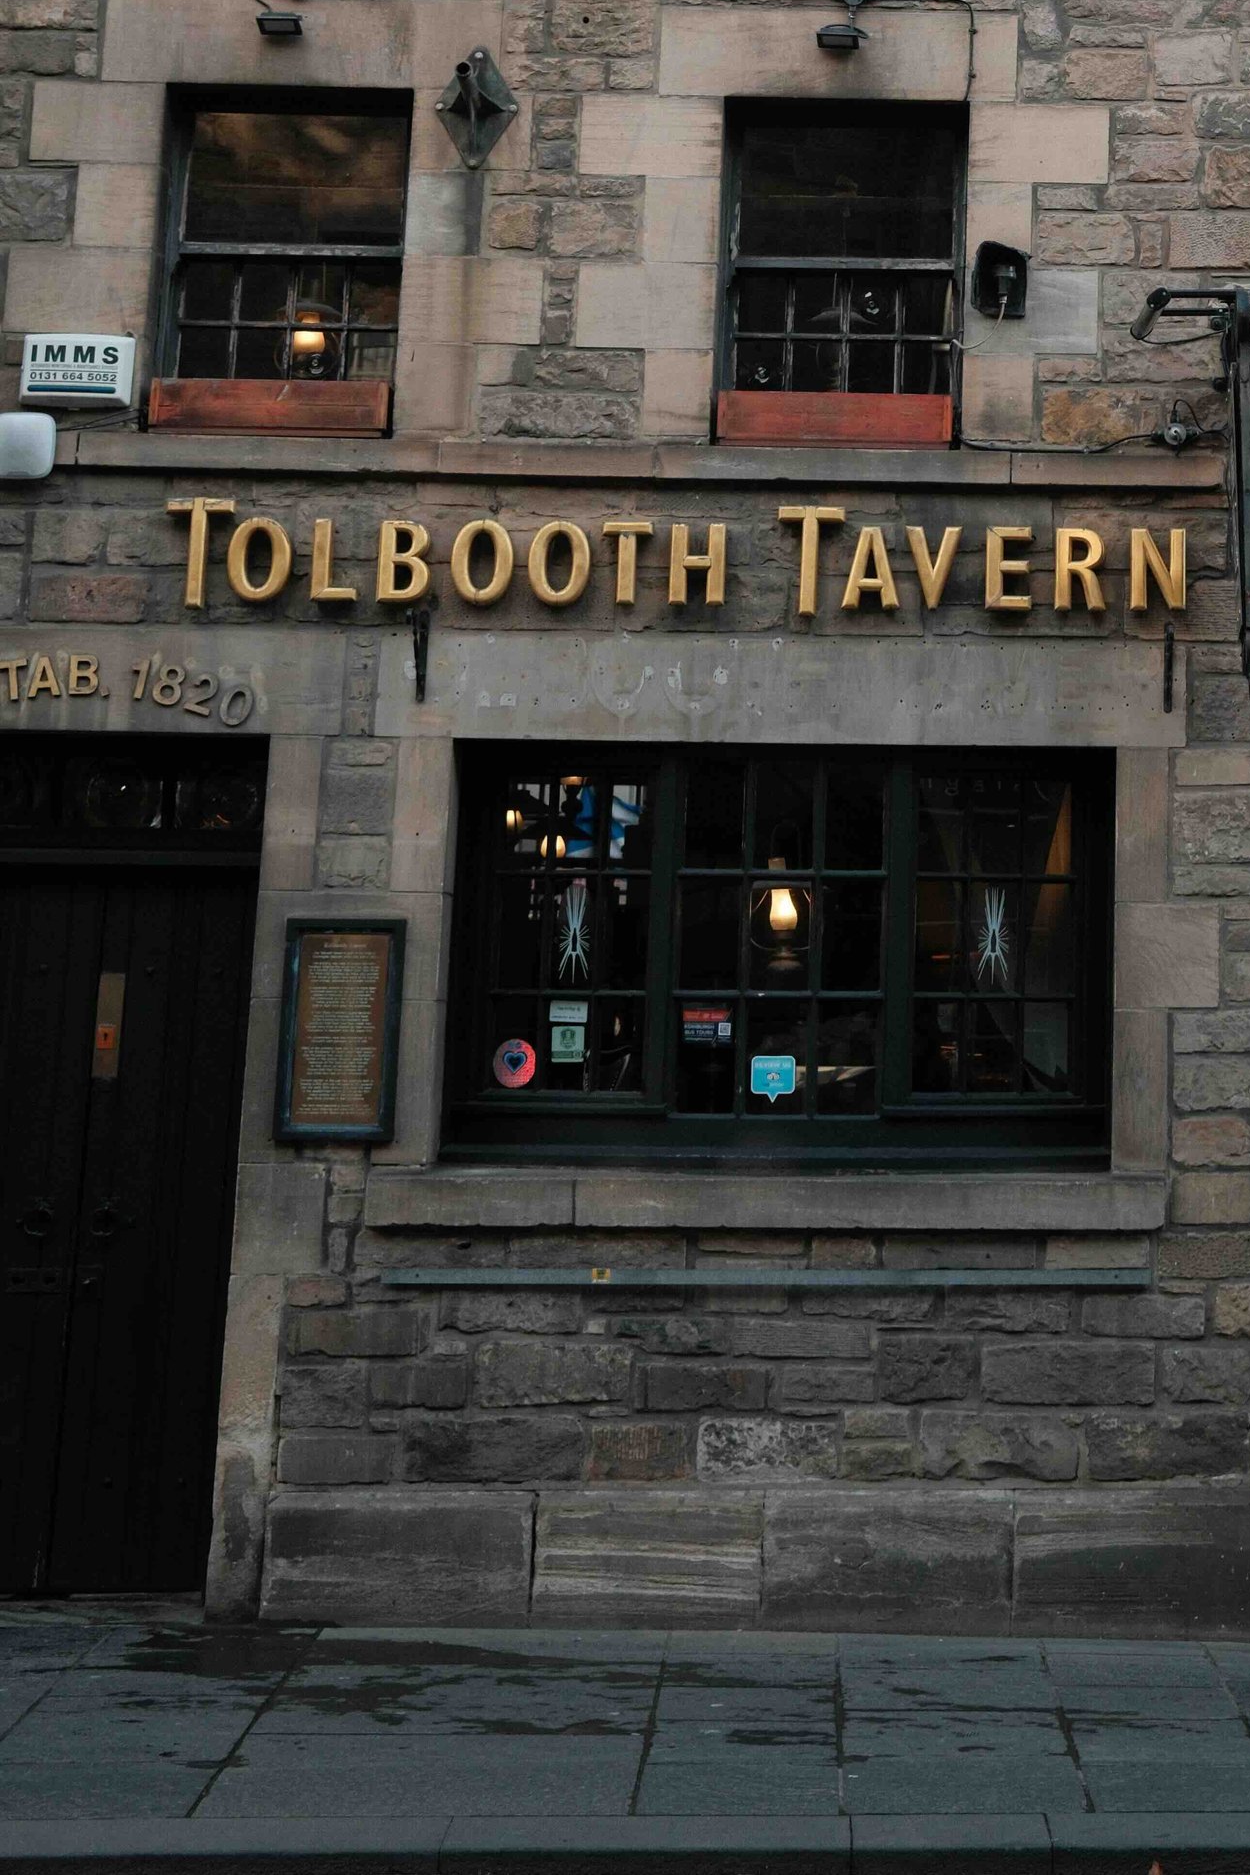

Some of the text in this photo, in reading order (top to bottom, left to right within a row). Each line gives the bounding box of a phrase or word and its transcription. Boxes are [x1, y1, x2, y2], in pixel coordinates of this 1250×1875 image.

[30, 371, 117, 382] 0131 664 5052
[166, 497, 1187, 617] TOLBOOTH TAVERN
[132, 659, 255, 726] 1820
